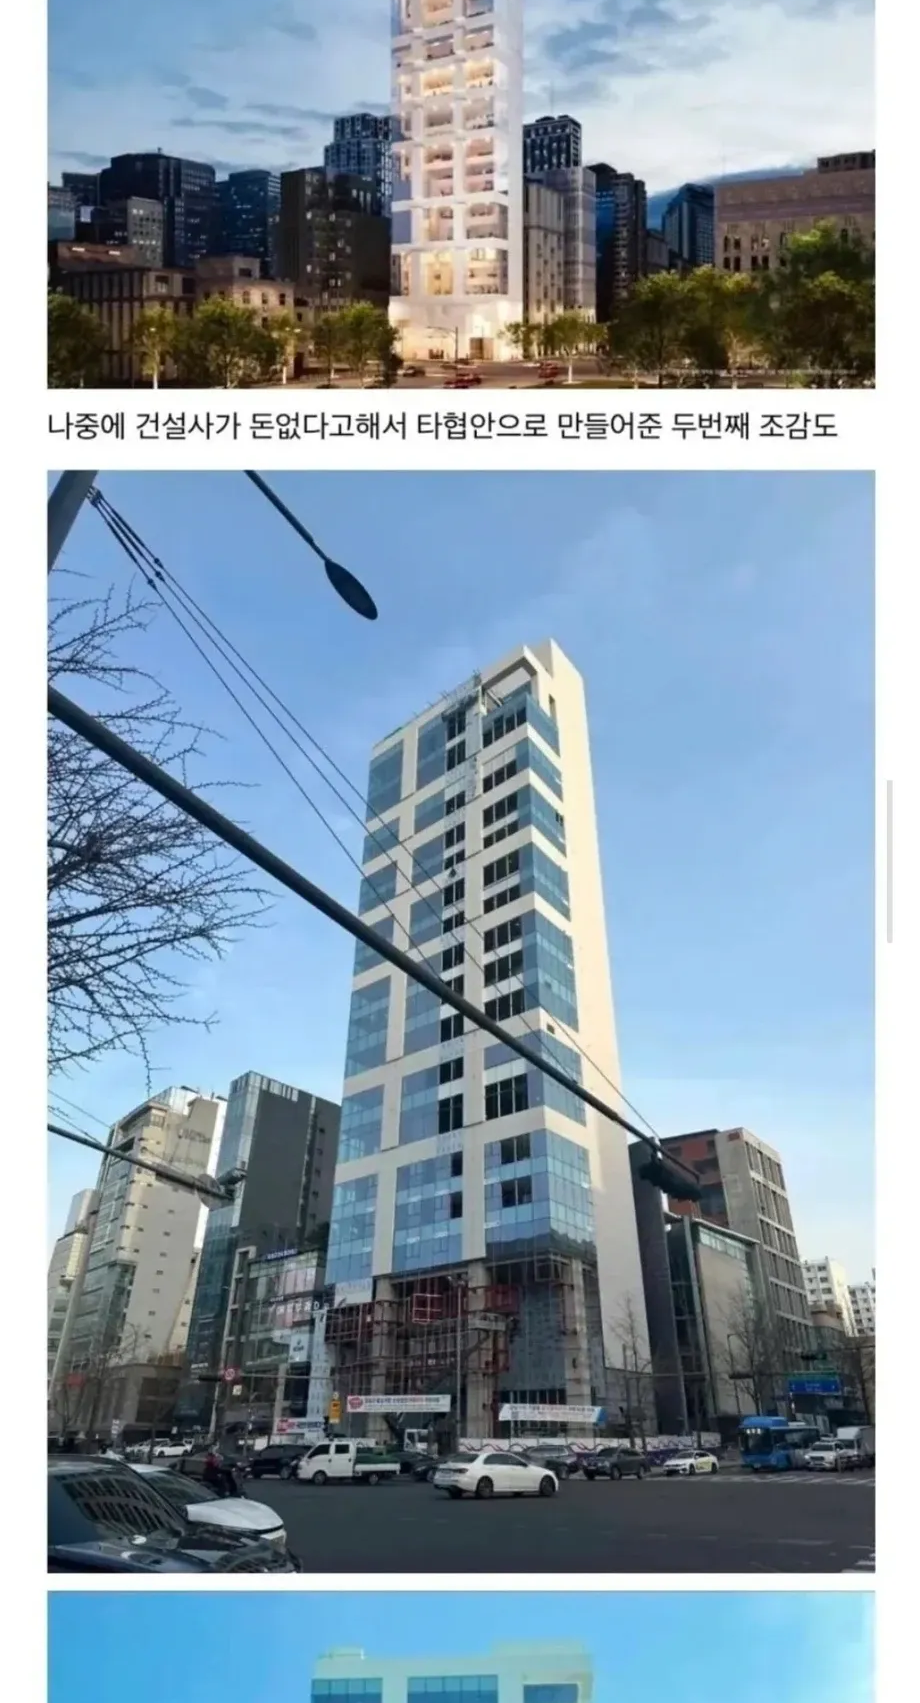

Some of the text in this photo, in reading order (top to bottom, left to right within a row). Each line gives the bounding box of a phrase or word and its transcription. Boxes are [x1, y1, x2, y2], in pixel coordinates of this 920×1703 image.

[48, 411, 839, 441] 나중에 건설사가 돈없다고해서 타협안으로 만들어준 두번째 조감도
